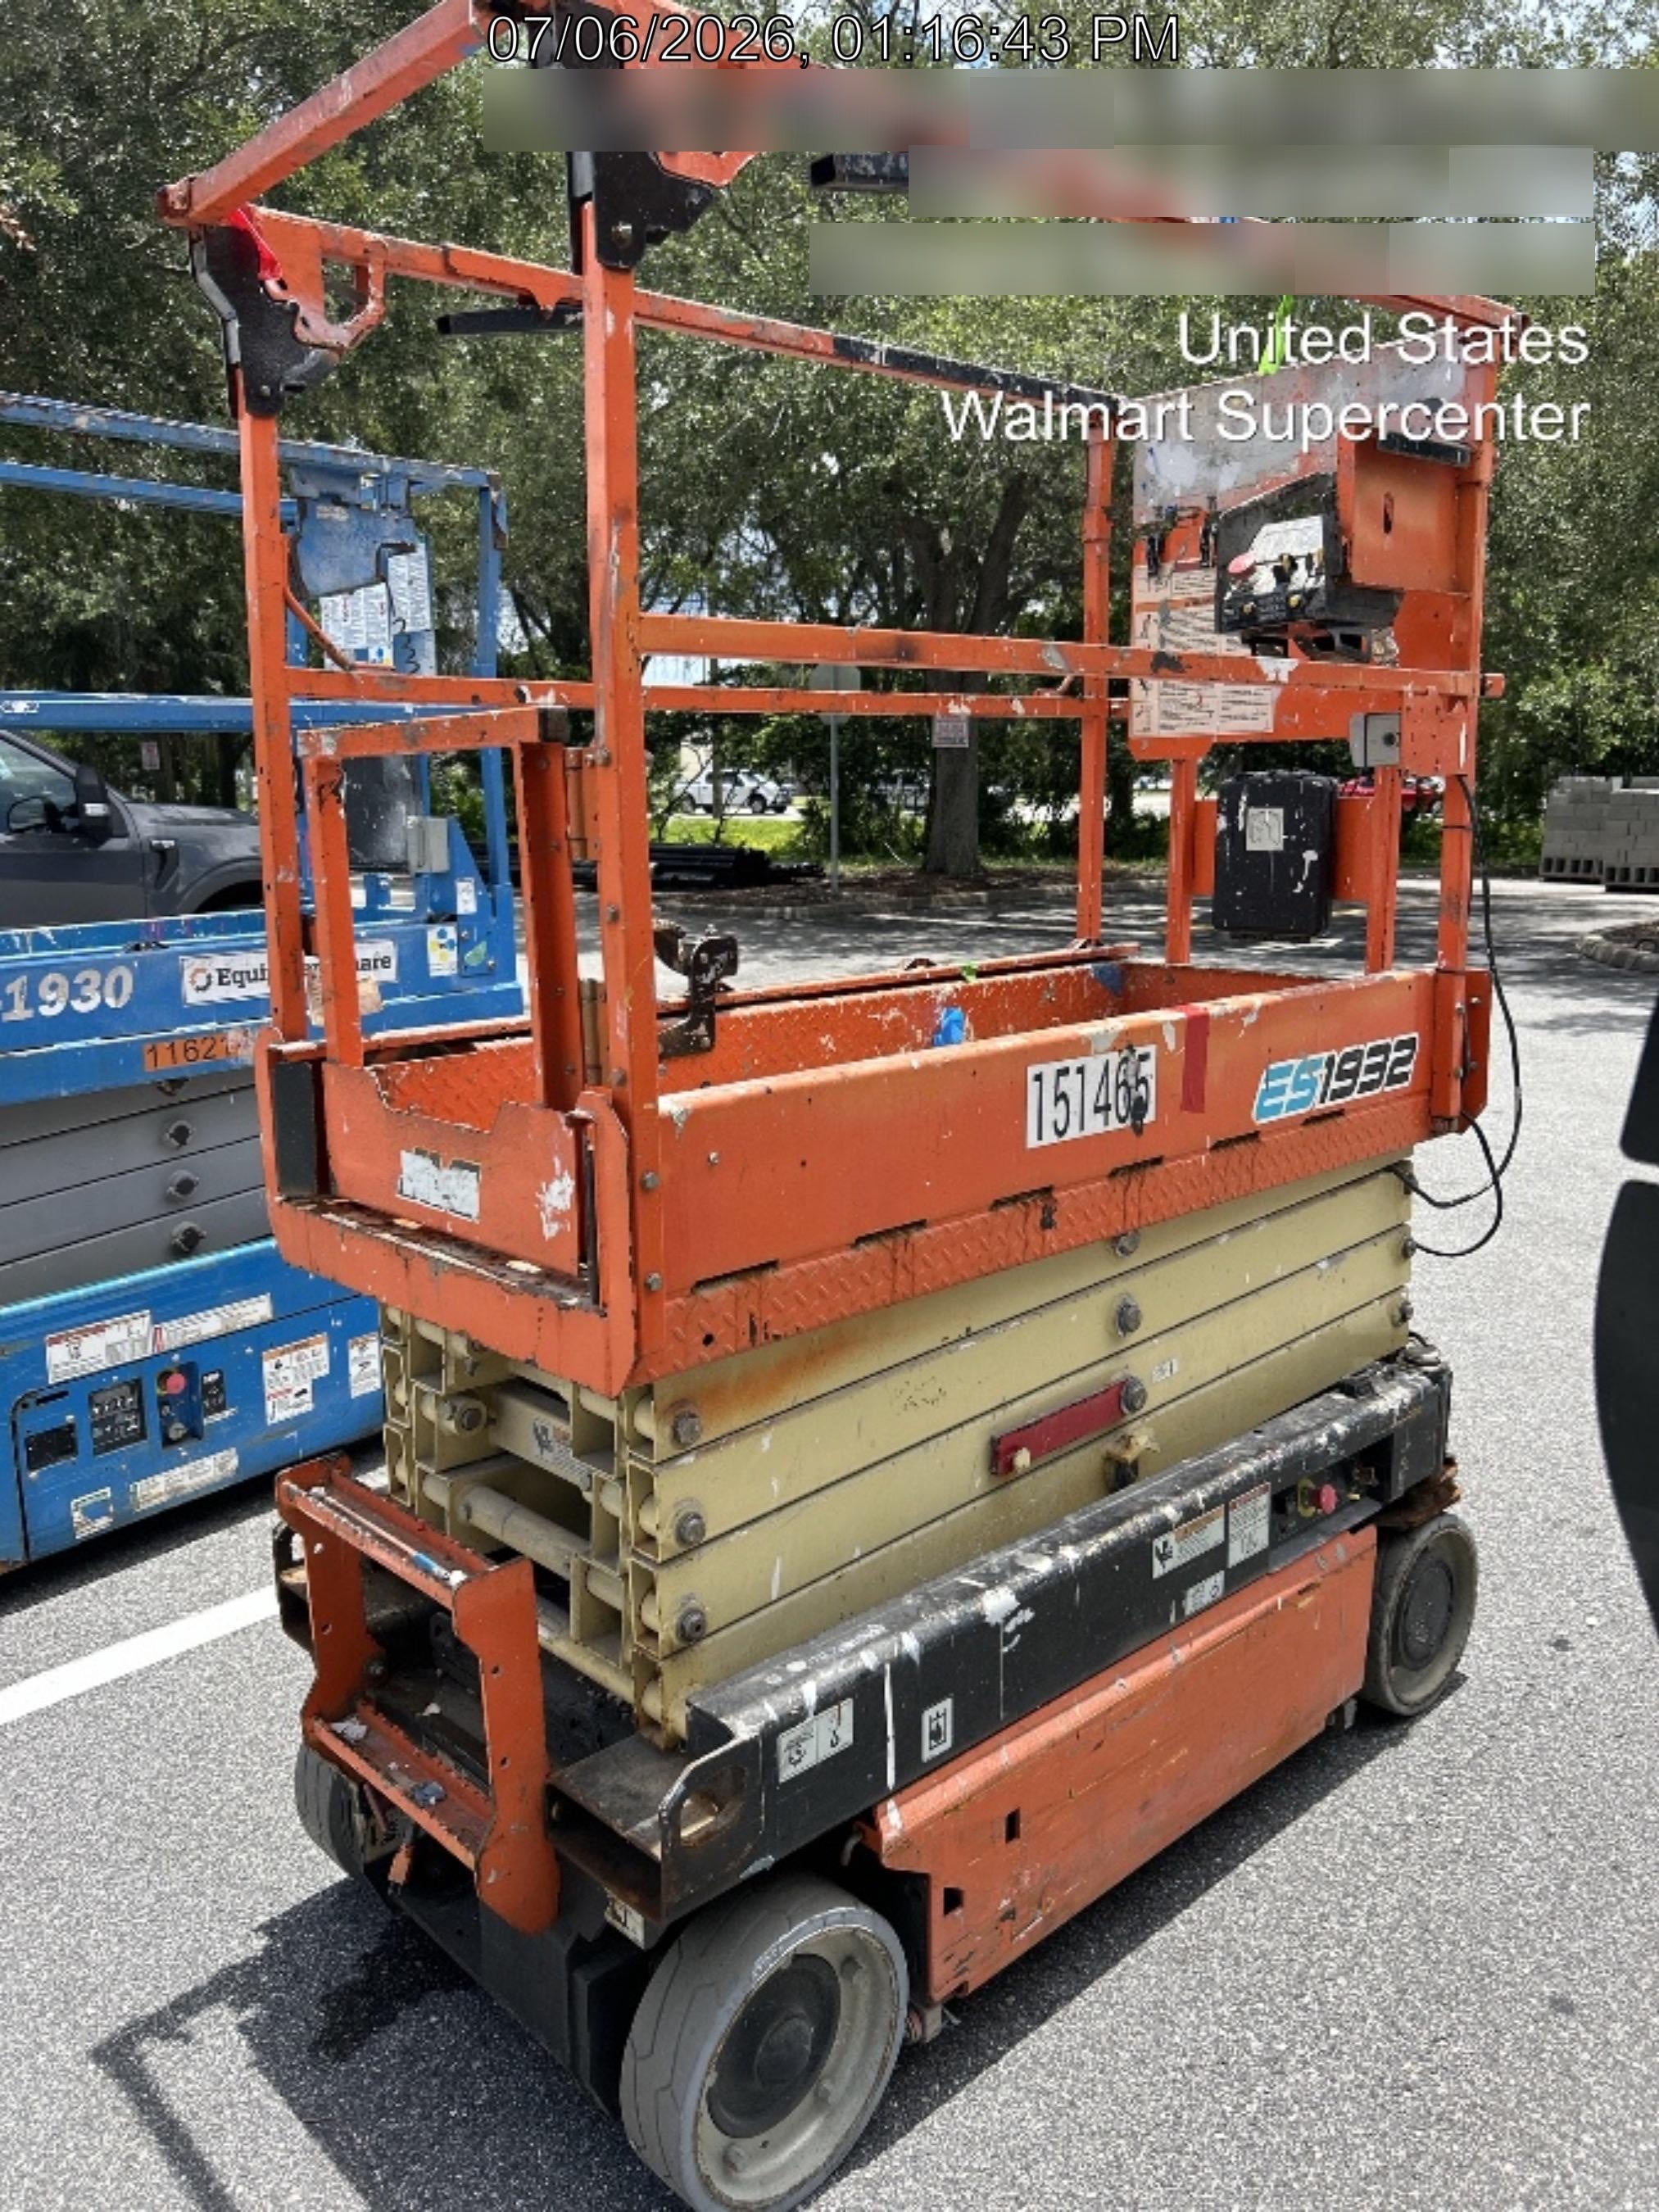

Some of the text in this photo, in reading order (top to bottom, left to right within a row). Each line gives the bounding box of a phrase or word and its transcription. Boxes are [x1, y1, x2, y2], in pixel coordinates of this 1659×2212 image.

[0, 964, 134, 1022] 1930
[1033, 1051, 1151, 1141] 151465
[1254, 1036, 1417, 1122] ES1932
